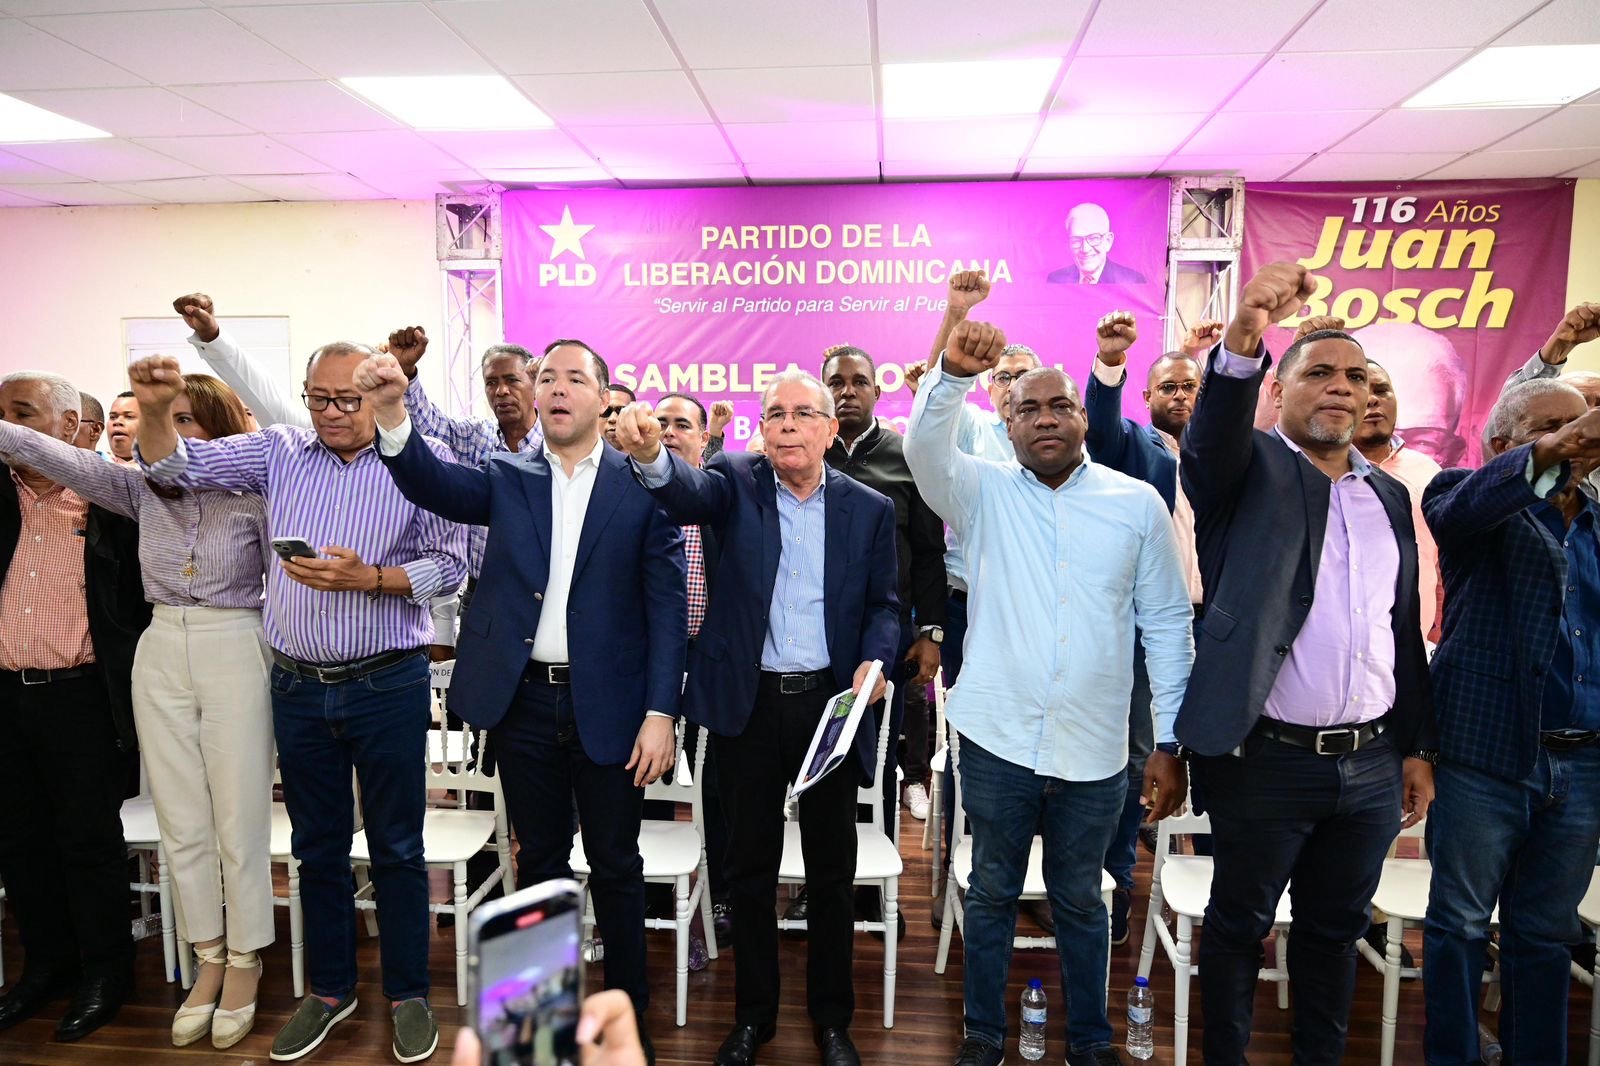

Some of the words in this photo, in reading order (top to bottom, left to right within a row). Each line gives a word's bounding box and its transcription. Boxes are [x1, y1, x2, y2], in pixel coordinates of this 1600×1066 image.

[1352, 197, 1417, 223] 116
[1424, 200, 1501, 223] Años
[701, 224, 832, 250] PARTIDO
[842, 224, 882, 248] DE
[893, 224, 932, 248] LA
[1296, 216, 1496, 269] Juan
[539, 263, 597, 287] PLD
[623, 254, 806, 286] LIBERACIÓN
[712, 297, 728, 313] al
[732, 297, 792, 313] Partido
[795, 299, 834, 315] para
[839, 296, 890, 312] Servir
[894, 296, 910, 311] al
[1277, 271, 1514, 329] Bosch
